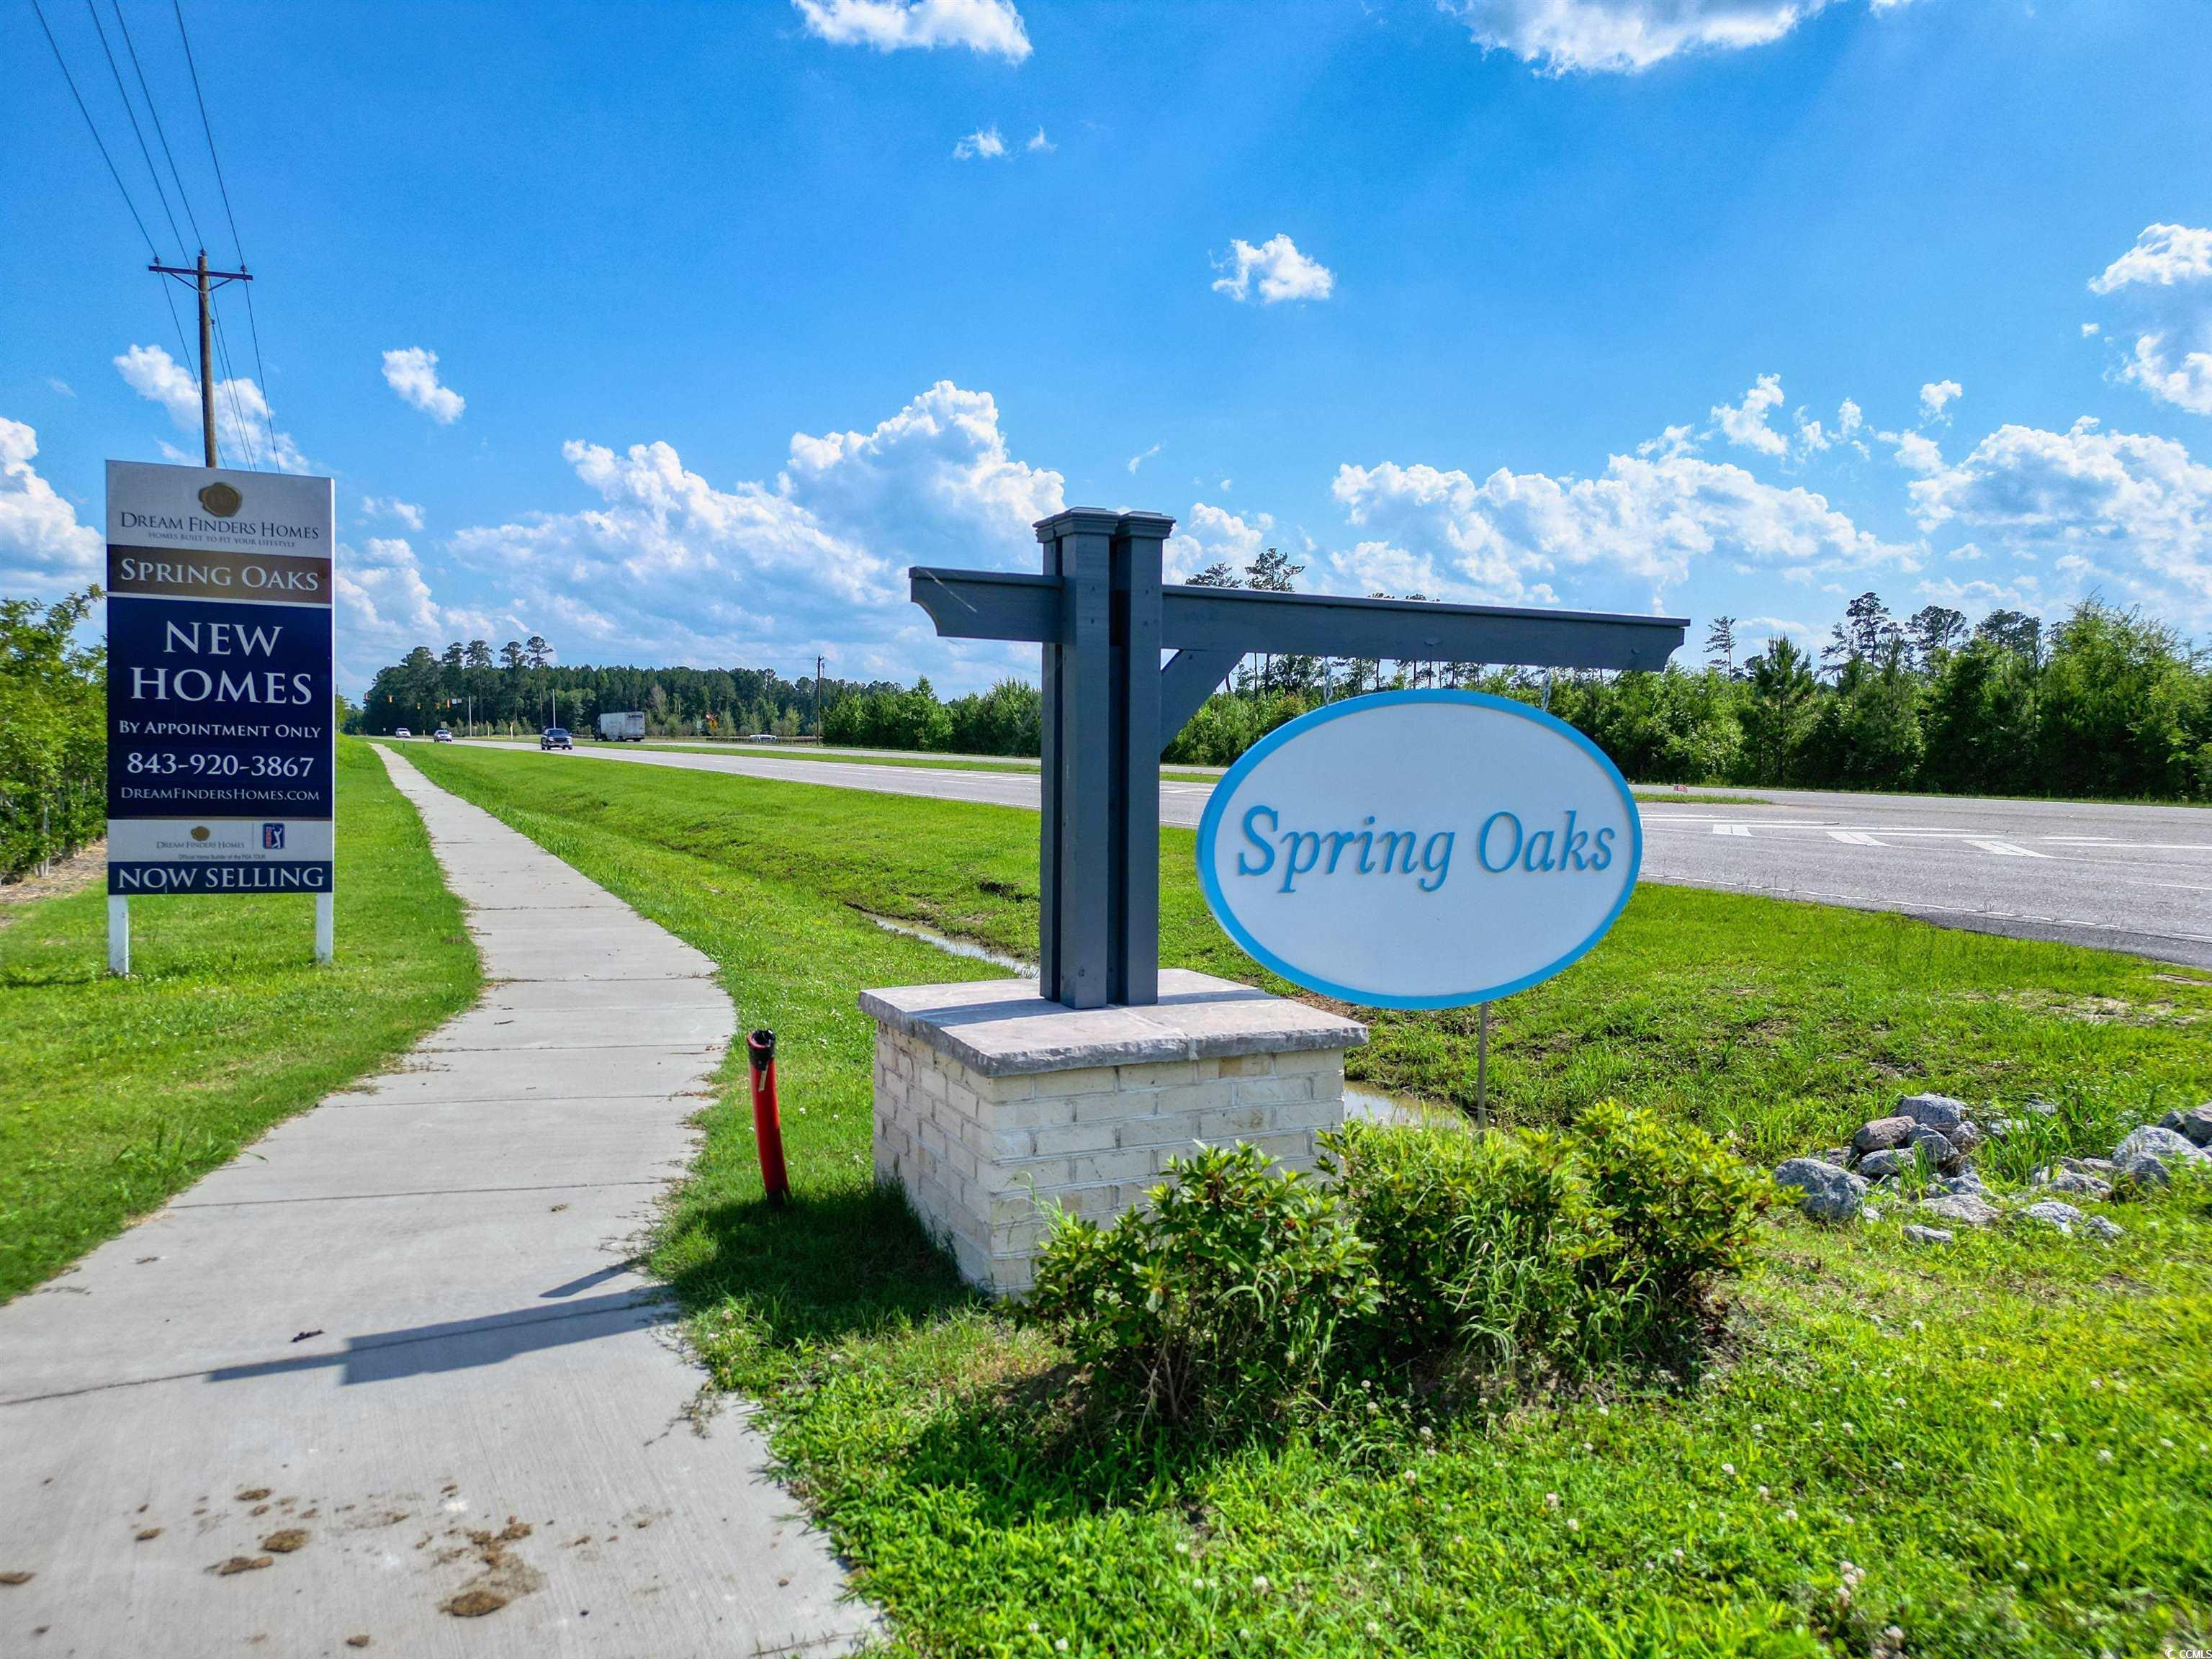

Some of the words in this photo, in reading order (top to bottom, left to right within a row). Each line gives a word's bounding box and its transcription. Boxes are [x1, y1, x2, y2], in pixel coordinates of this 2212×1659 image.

[121, 511, 183, 529] DREAM
[189, 516, 256, 535] FINDERS
[261, 521, 319, 539] HOMES
[121, 558, 231, 586] SPRING
[242, 565, 318, 591] OAKS
[163, 620, 283, 657] NEW
[130, 667, 312, 705] HOMES
[120, 720, 140, 734] BY
[144, 721, 270, 737] APPOINTMENT
[275, 724, 322, 739] ONLY
[127, 752, 314, 777] 843-920-3867
[1237, 804, 1455, 894] Spring
[1478, 810, 1616, 873] Oaks
[117, 868, 198, 889] NOW
[205, 867, 323, 888] SELLING
